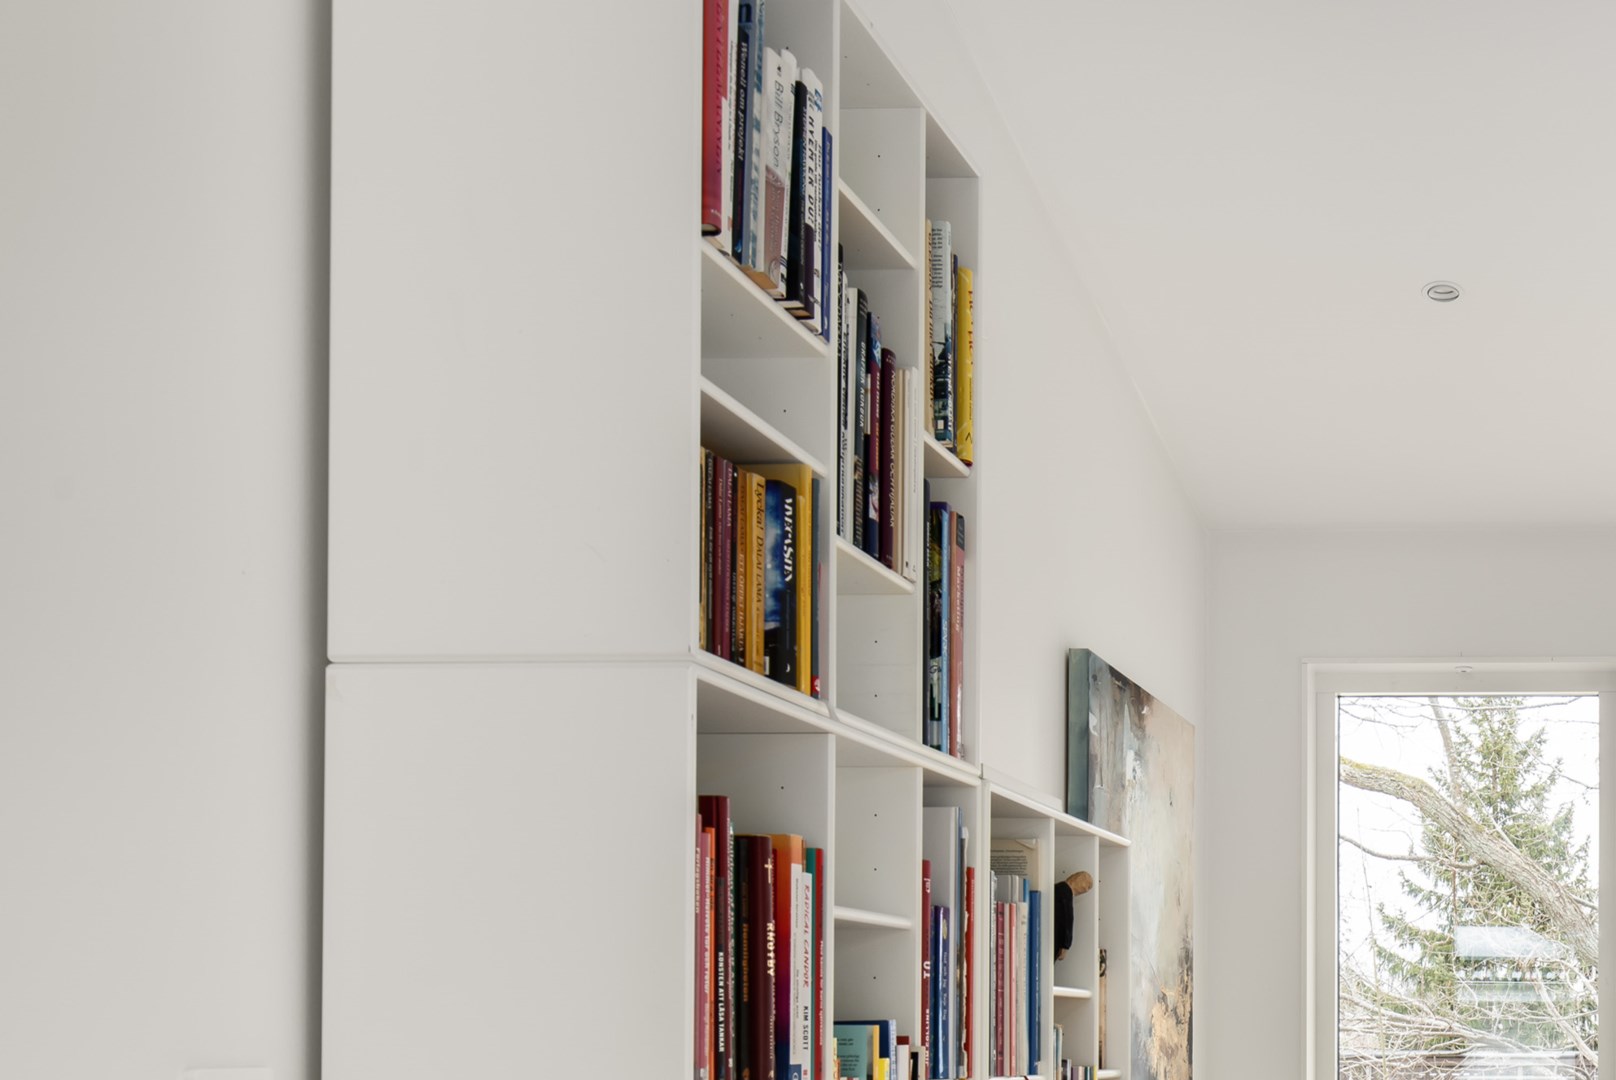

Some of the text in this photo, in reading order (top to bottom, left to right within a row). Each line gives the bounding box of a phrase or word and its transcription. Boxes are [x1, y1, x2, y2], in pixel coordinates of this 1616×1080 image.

[740, 89, 745, 110] om
[774, 80, 785, 108] Bill
[772, 111, 784, 168] Bryson
[754, 481, 765, 530] Lycka!
[756, 536, 764, 571] DALAI
[803, 884, 811, 934] RADICAL
[766, 922, 776, 977] KNUTBY
[802, 938, 810, 989] CANDOR
